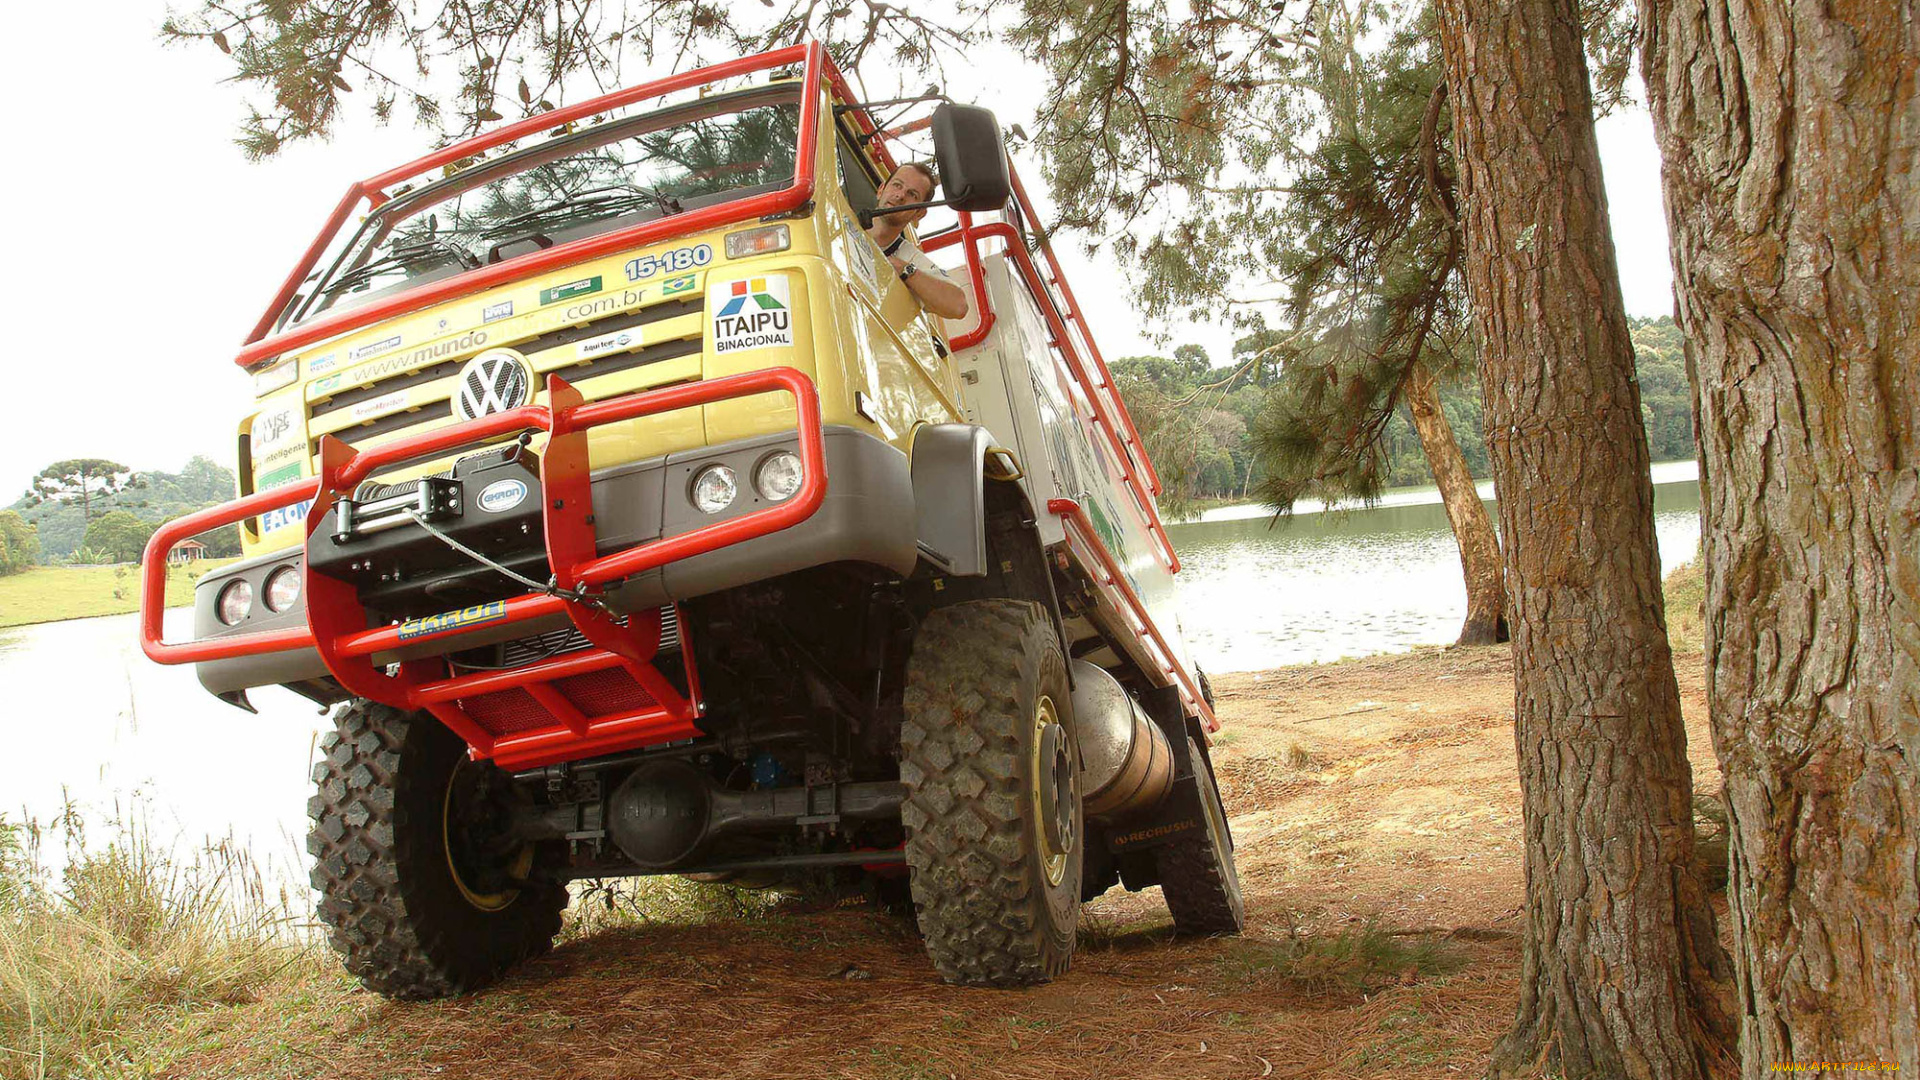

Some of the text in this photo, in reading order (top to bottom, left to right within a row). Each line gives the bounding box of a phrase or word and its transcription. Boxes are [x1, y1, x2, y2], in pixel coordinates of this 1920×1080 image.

[626, 244, 712, 281] 15-180
[716, 311, 788, 339] ITAIPU
[716, 334, 790, 352] BINACIONAL
[263, 424, 290, 443] UP
